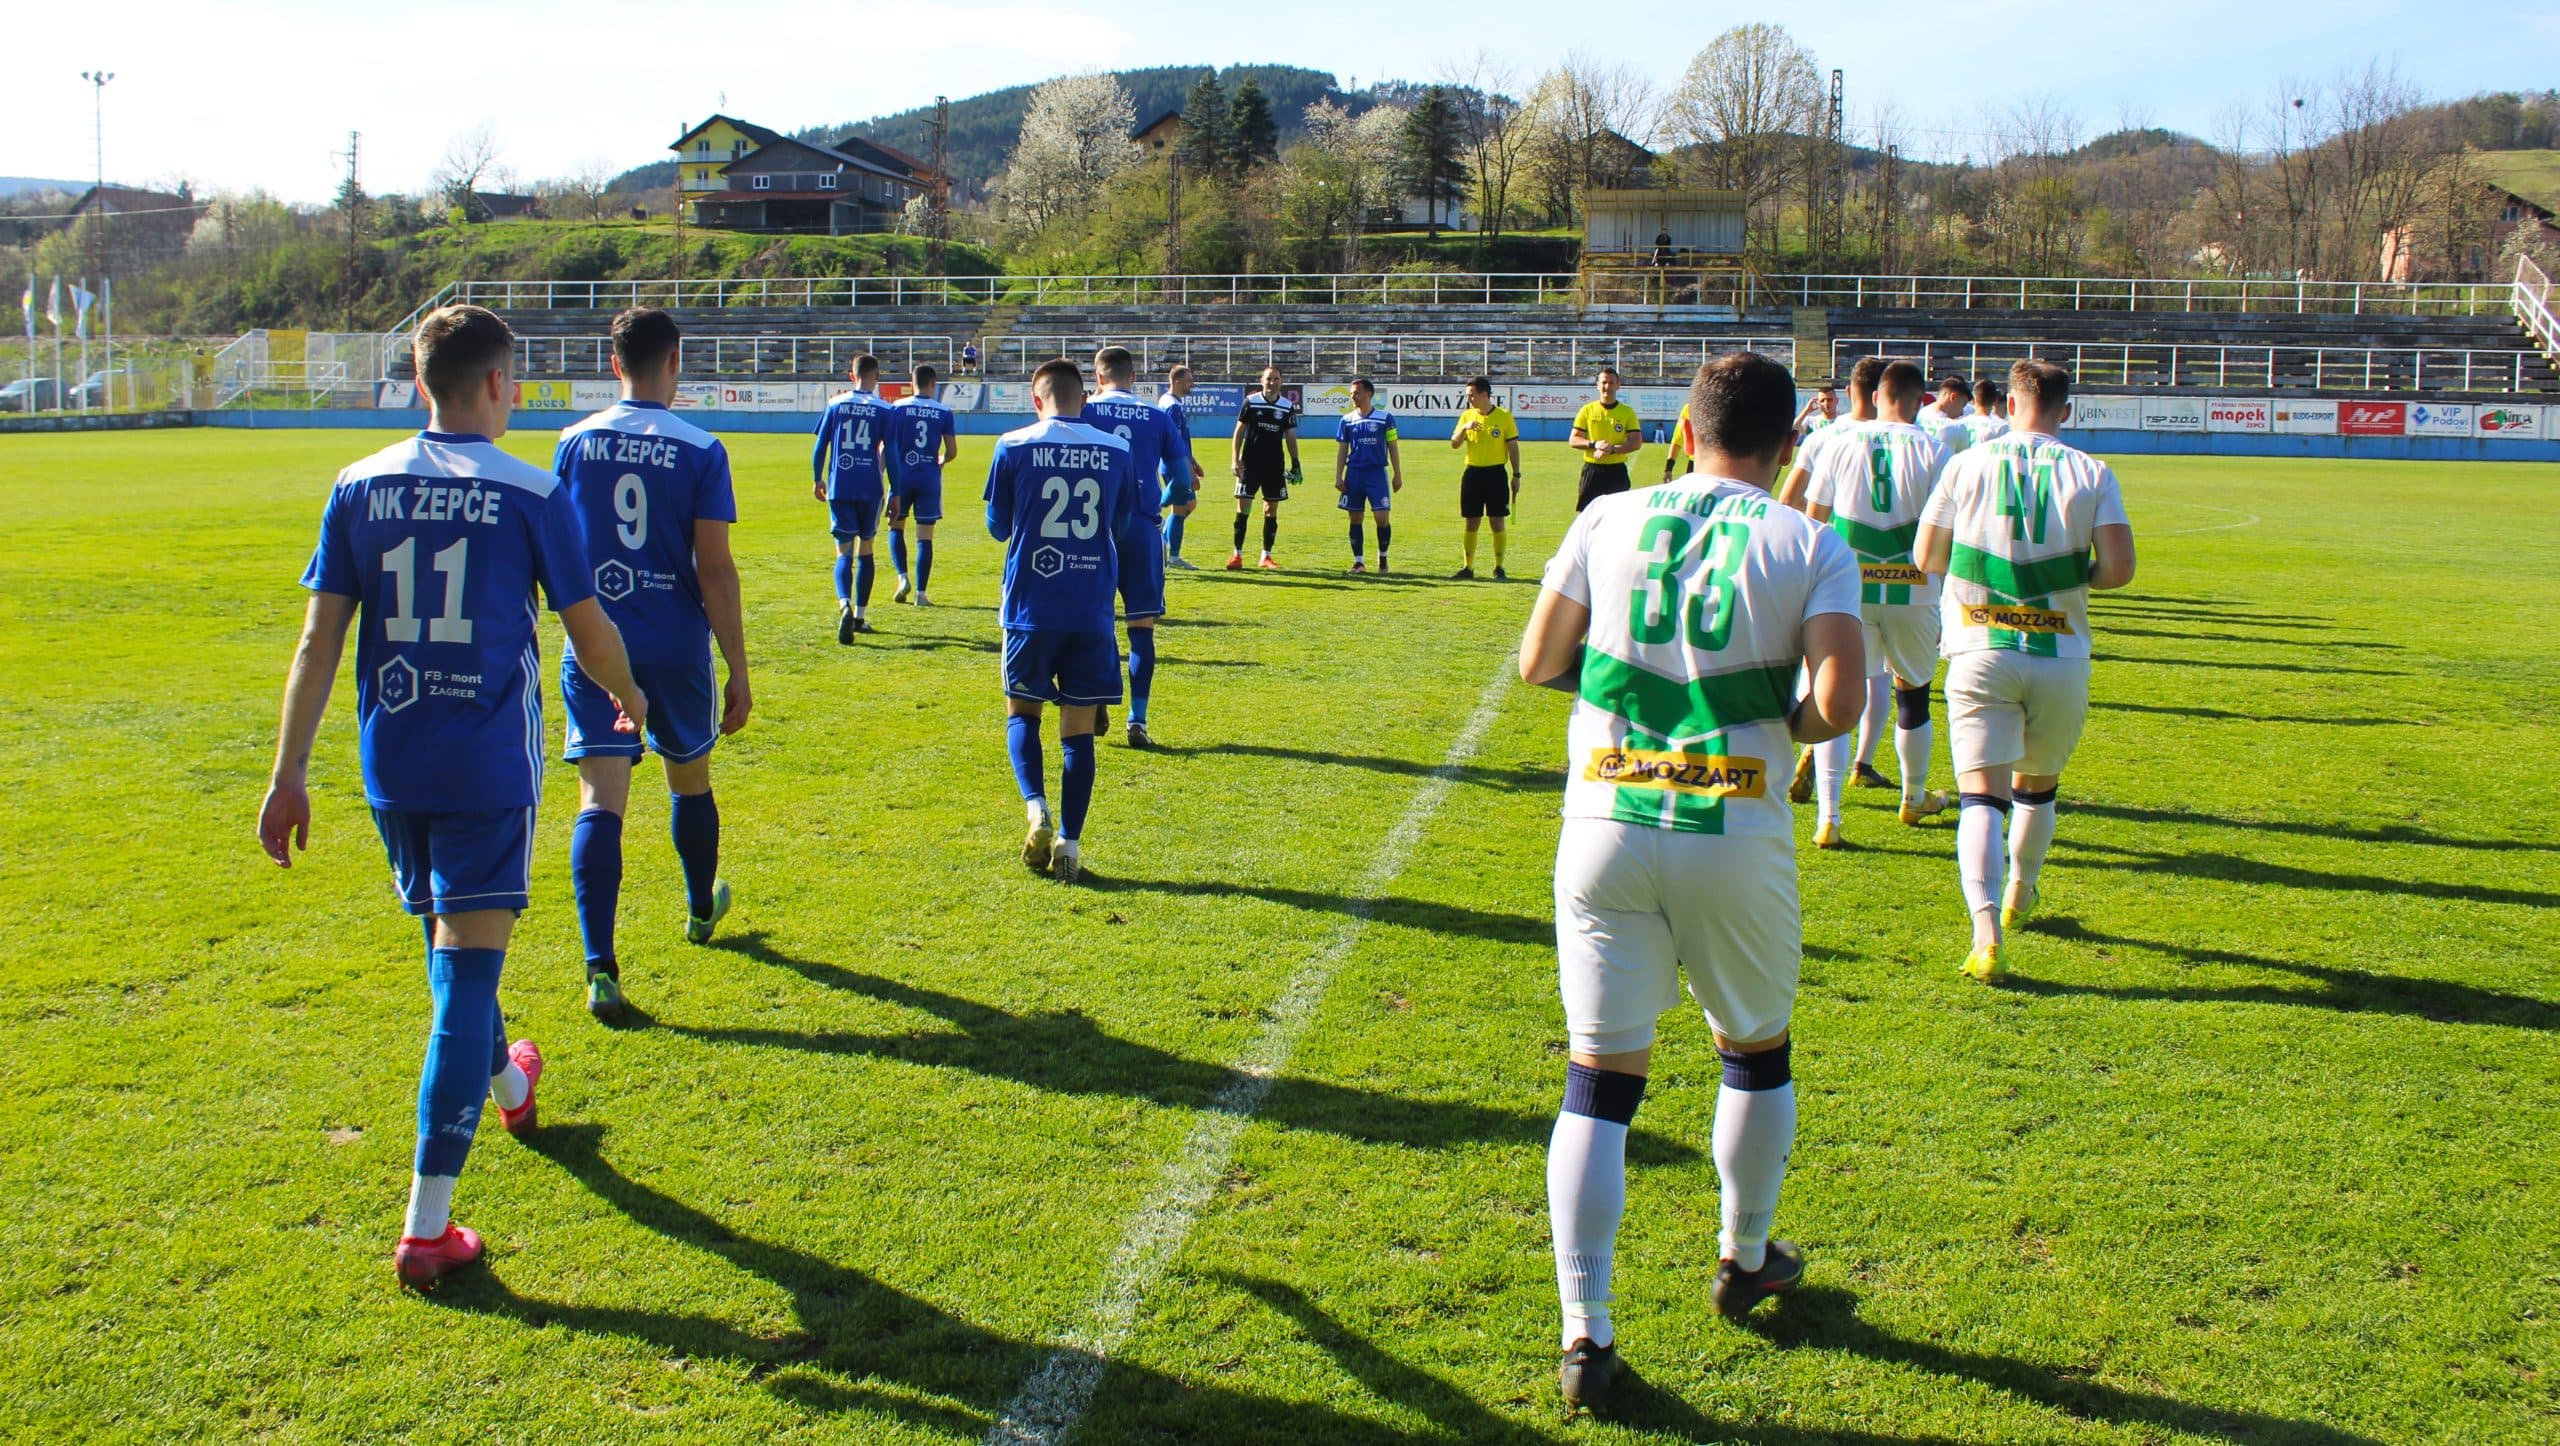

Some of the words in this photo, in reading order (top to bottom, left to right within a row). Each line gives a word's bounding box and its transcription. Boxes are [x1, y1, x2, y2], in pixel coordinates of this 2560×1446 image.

[738, 390, 753, 402] JUB
[1392, 390, 1451, 410] OPĆINA
[839, 404, 851, 415] NK
[851, 403, 877, 417] ŽEPČE
[906, 407, 917, 416] NK
[917, 406, 940, 419] ŽEPČE
[1096, 404, 1112, 417] NK
[1114, 404, 1150, 421] ŽEPČE
[2145, 415, 2168, 423] TSP
[2211, 408, 2265, 424] mapek
[2441, 407, 2461, 416] VIP
[2432, 416, 2469, 426] Podovi
[841, 418, 872, 451] 14
[914, 420, 928, 448] 3
[582, 437, 612, 462] NK
[615, 433, 678, 469] ŽEPČE
[1032, 447, 1056, 467] NK
[1059, 444, 1110, 471] ŽEPČE
[1871, 447, 1893, 513] 8
[368, 486, 406, 522] NK
[412, 479, 502, 526] ŽEPČE
[613, 472, 648, 550] 9
[1040, 475, 1101, 540] 23
[1647, 490, 1680, 511] NK
[1629, 514, 1751, 652] 33
[1863, 568, 1922, 581] MOZZART
[382, 536, 473, 644] 11
[1995, 612, 2065, 630] MOZZART
[1631, 759, 1758, 790] MOZZART
